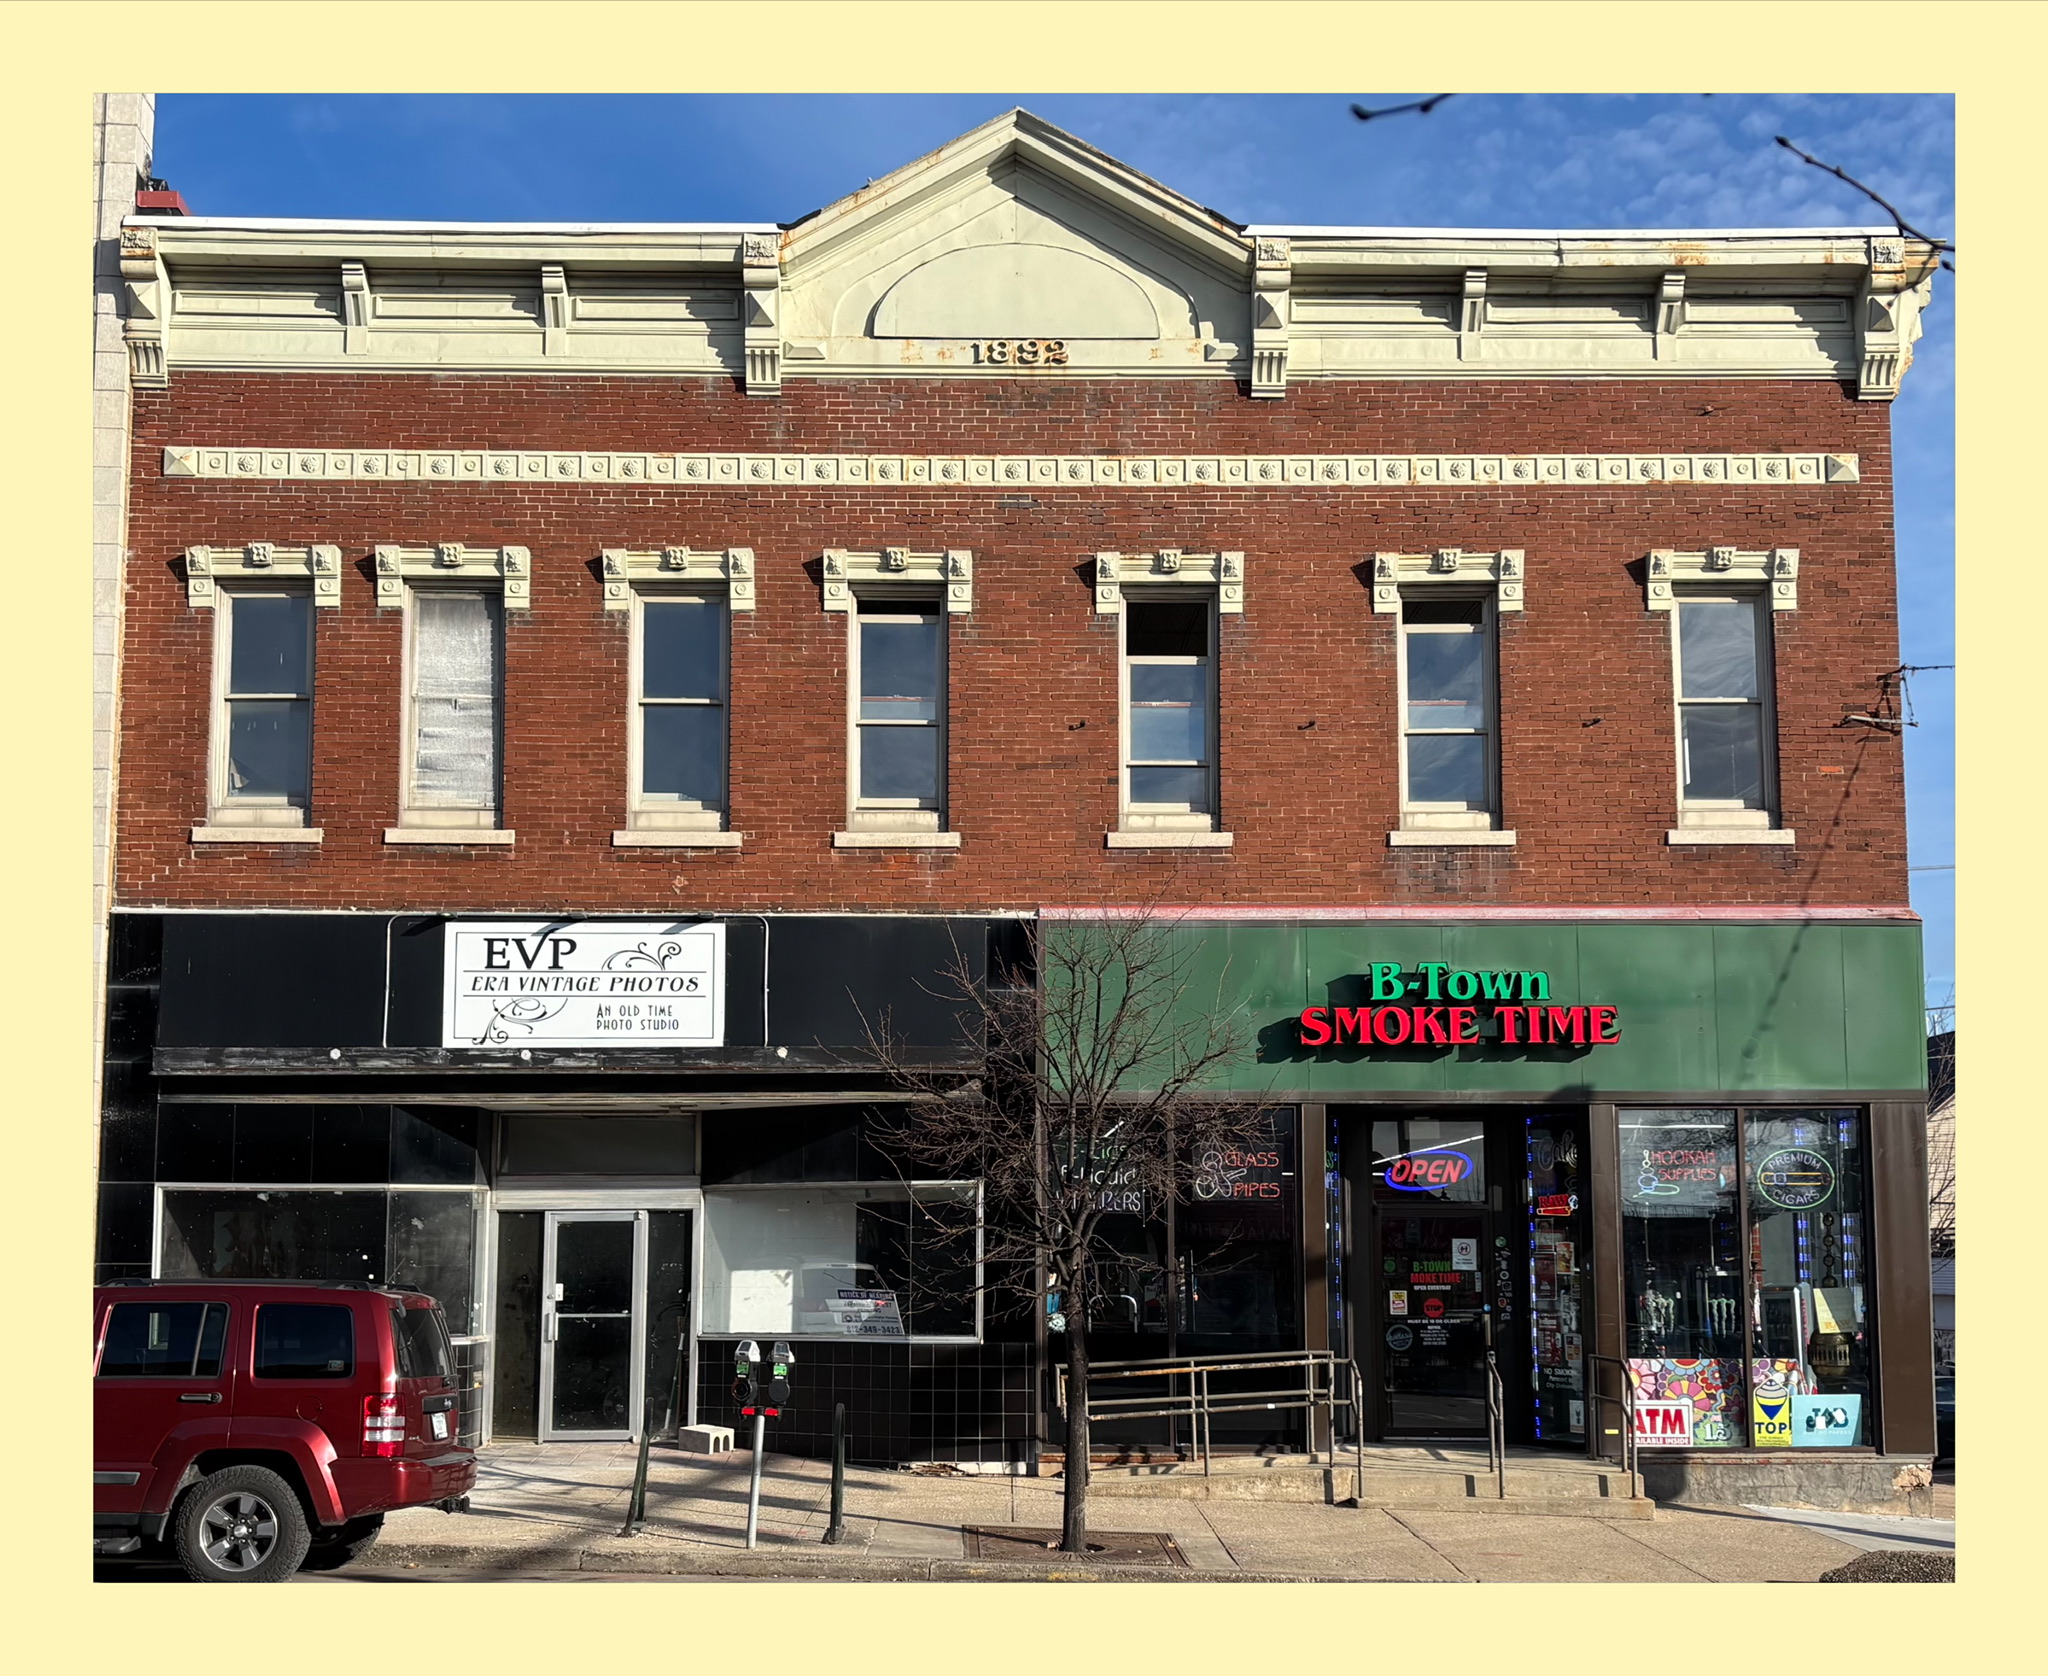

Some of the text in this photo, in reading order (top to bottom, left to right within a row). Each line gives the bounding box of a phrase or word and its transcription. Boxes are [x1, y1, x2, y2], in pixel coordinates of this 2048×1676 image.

[970, 340, 1069, 365] 1892
[484, 929, 577, 970] EVP
[471, 976, 700, 992] ERA VINTAGE PHOTOS
[1368, 961, 1552, 1001] B-Town
[619, 1004, 640, 1018] OLD
[647, 1004, 673, 1018] TIME
[596, 1018, 680, 1031] PHOTO STUDIO
[1300, 1005, 1622, 1046] SMOKE TIME
[1225, 1151, 1280, 1168] GLASS
[1650, 1150, 1716, 1166] HOOKAH
[1768, 1152, 1822, 1170] PREMIUM
[1391, 1159, 1463, 1184] OPEN
[1658, 1167, 1717, 1181] SUPPLIES
[1233, 1182, 1281, 1198] PIPES
[1772, 1189, 1820, 1205] CIGARS
[1412, 1261, 1451, 1273] B-TOWN
[1439, 1272, 1462, 1284] TIME
[1632, 1408, 1686, 1434] ATM
[1755, 1422, 1788, 1435] TOP
[1665, 1437, 1689, 1445] INSIDE
